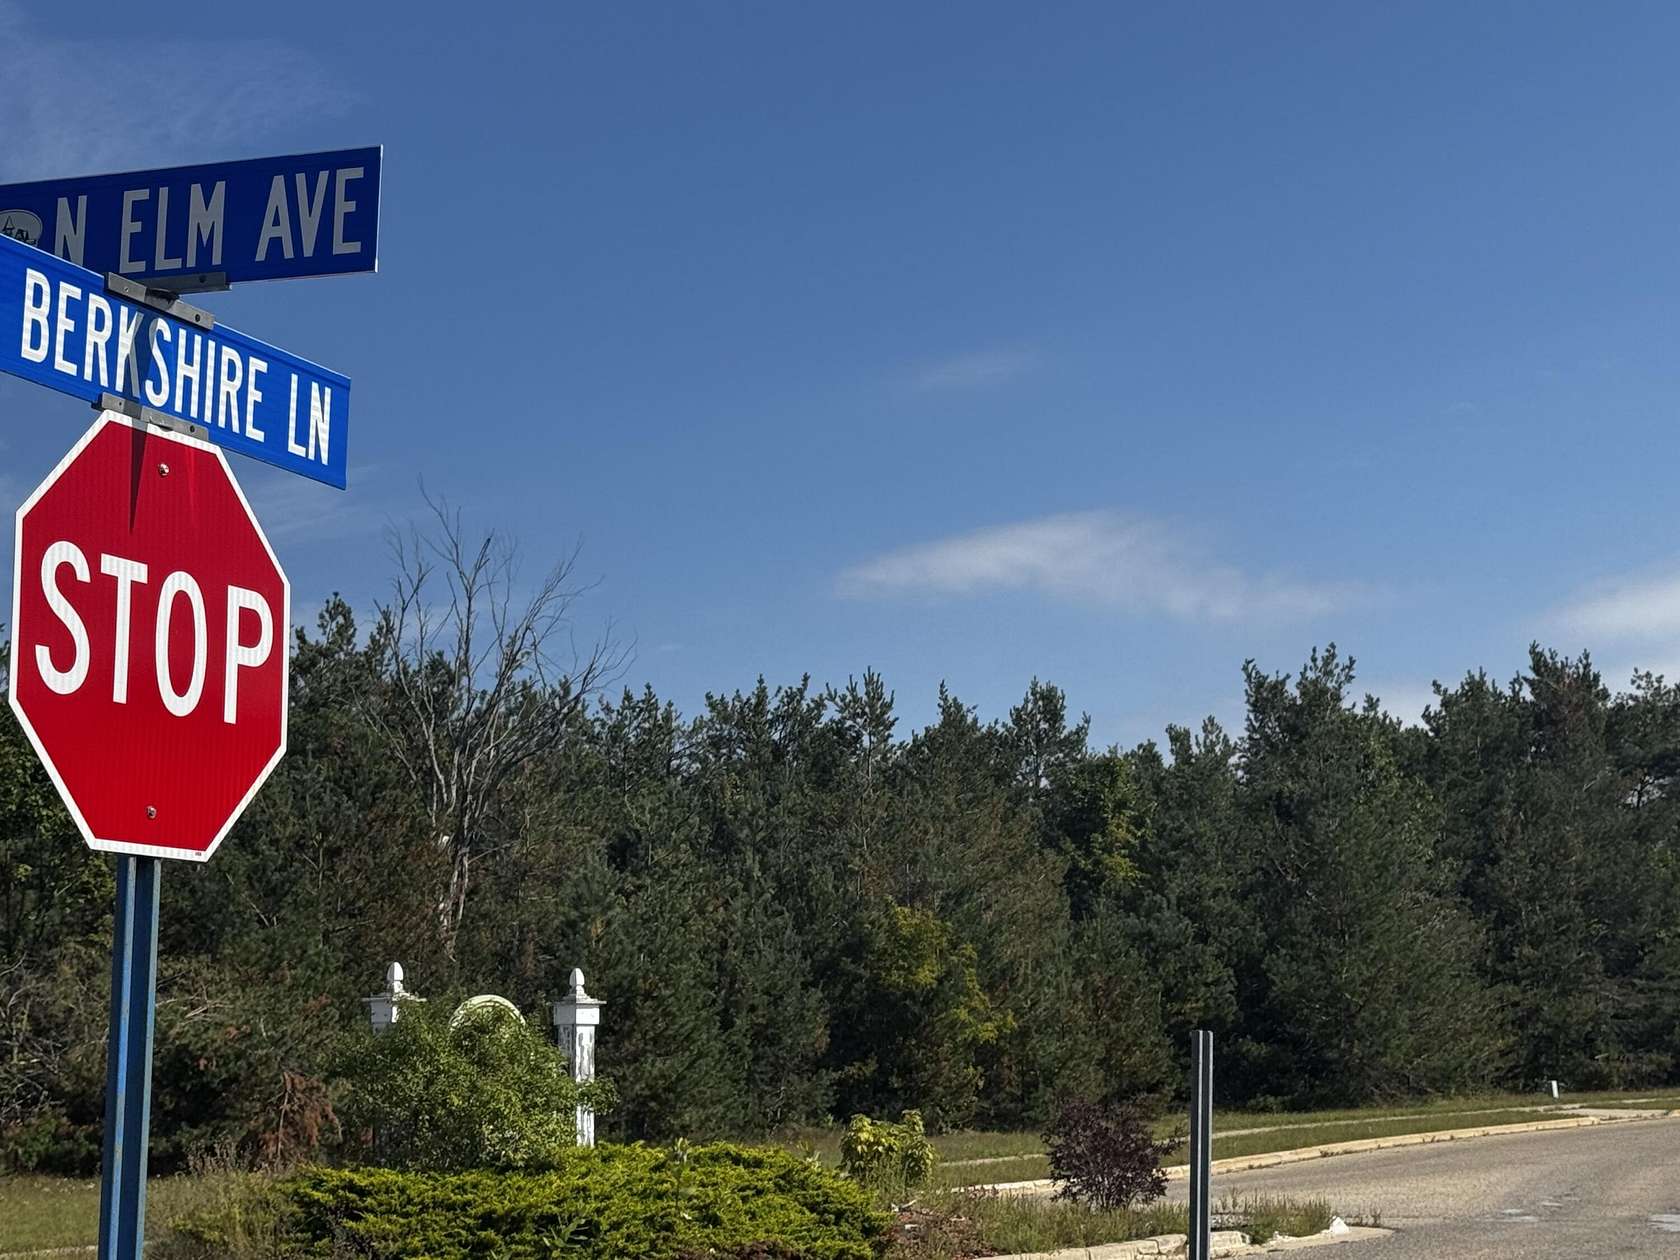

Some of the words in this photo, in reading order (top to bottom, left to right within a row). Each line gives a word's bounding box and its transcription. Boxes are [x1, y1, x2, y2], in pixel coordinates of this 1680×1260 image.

[55, 195, 87, 266] N
[119, 181, 226, 273] ELM
[255, 167, 364, 261] AVE
[21, 268, 268, 442] BERKSHIRE
[287, 374, 331, 465] LN
[35, 541, 273, 724] STOP
